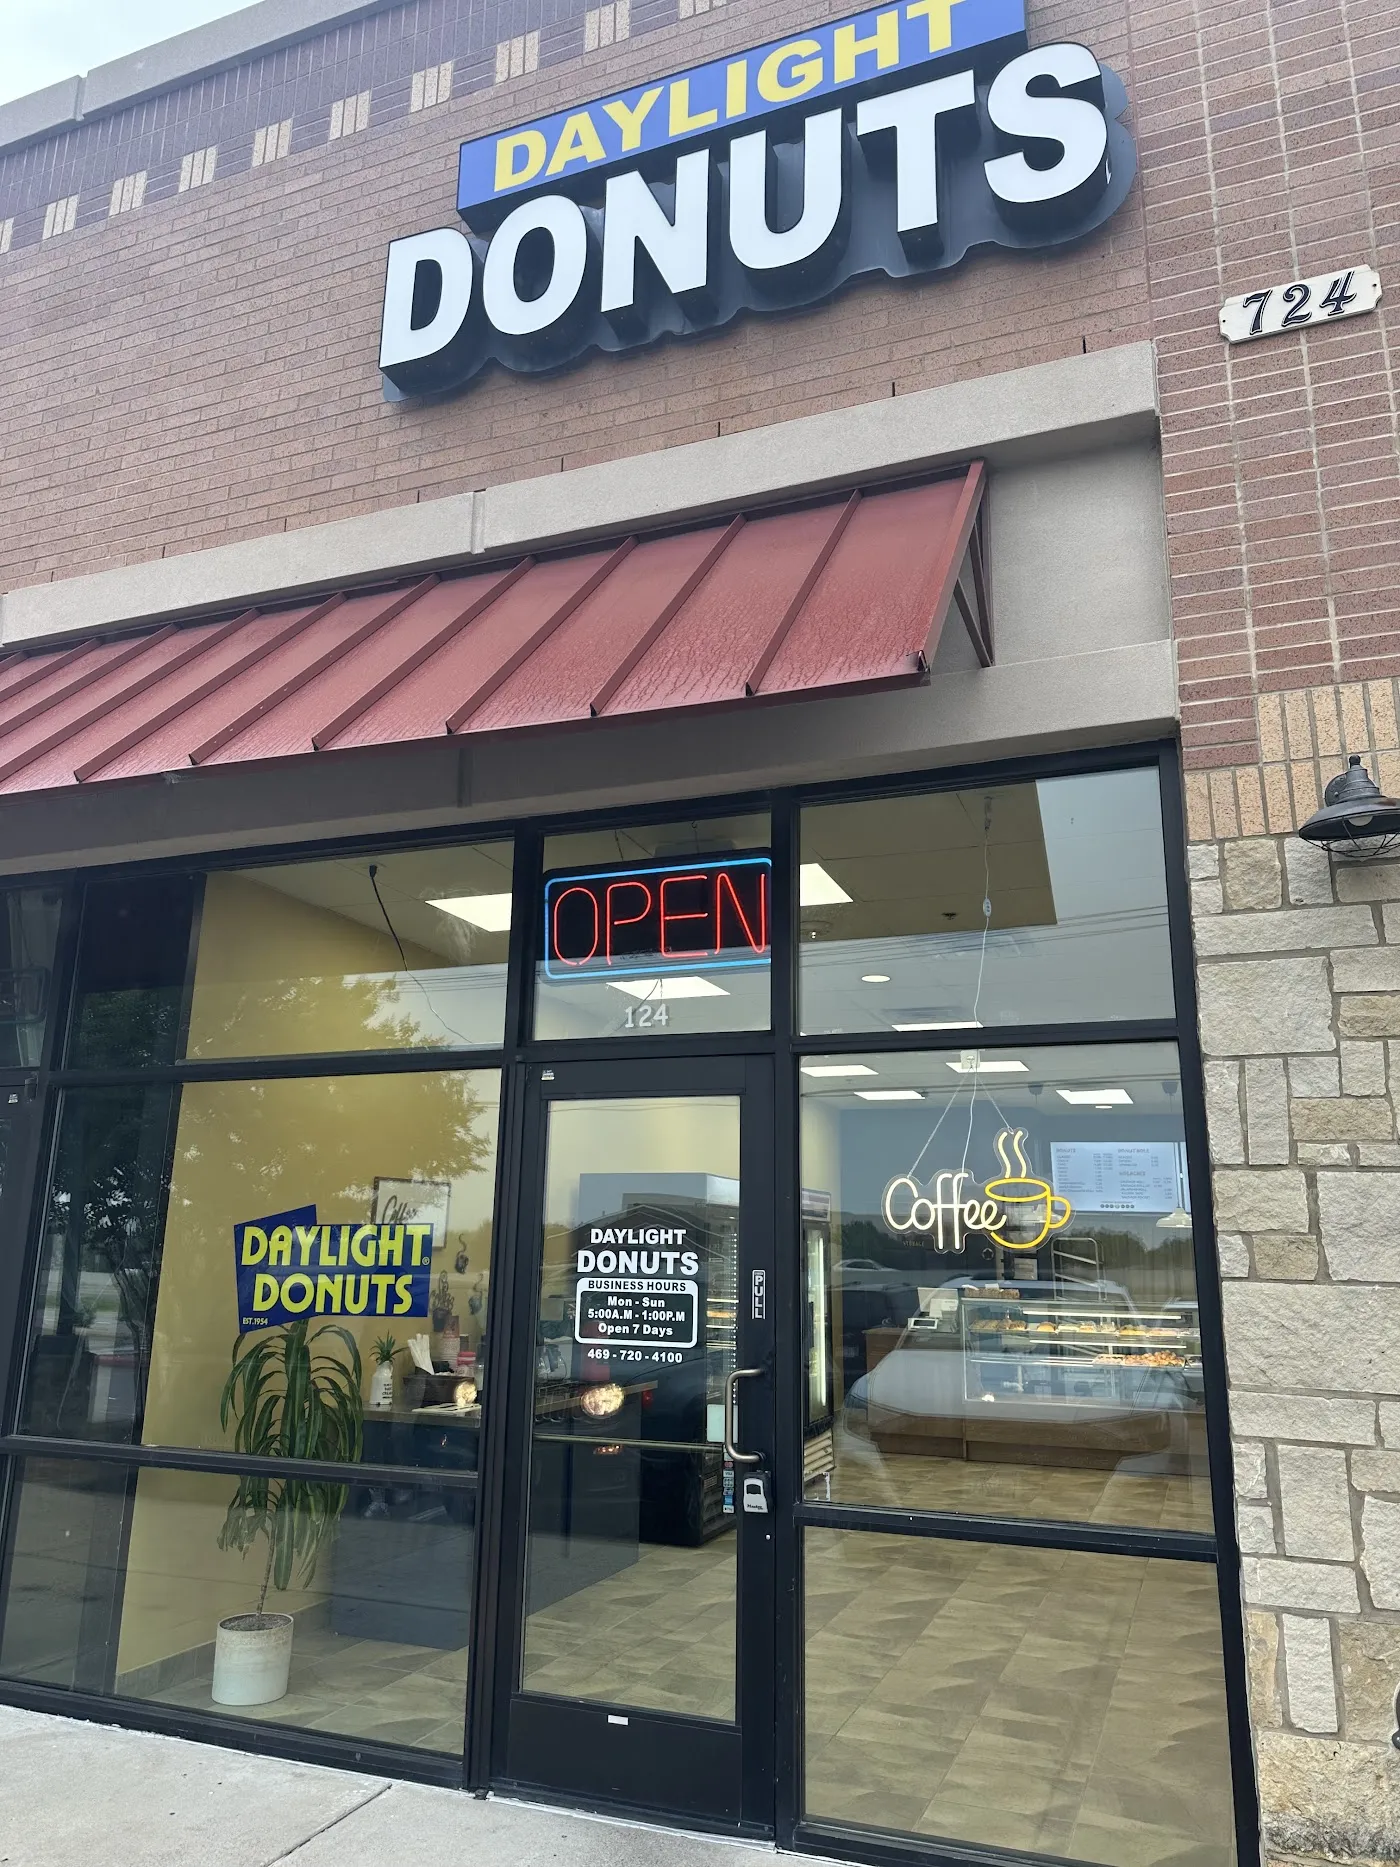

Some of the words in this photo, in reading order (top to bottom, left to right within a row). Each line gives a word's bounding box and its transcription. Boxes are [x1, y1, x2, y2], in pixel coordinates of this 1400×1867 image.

[493, 0, 967, 193] DAYLIGHT
[378, 42, 1108, 368] DONUTS
[1242, 271, 1357, 335] 724
[553, 872, 766, 967] OPEN
[624, 1003, 668, 1028] 124
[885, 1172, 1007, 1250] Coffee
[590, 1228, 686, 1245] DAYLIGHT
[577, 1250, 699, 1275] DONUTS
[253, 1273, 412, 1314] DONUTS
[588, 1280, 643, 1290] BUSINESS
[647, 1281, 686, 1291] HOURS
[754, 1275, 763, 1319] PULL
[607, 1296, 632, 1307] Mon
[642, 1297, 665, 1308] Sun
[242, 1317, 268, 1326] EST.1954
[588, 1309, 632, 1320] 5:00A.M
[642, 1310, 685, 1322] 1:00P.M
[598, 1324, 629, 1335] Open
[633, 1324, 639, 1334] 7
[643, 1325, 673, 1337] Days
[588, 1348, 610, 1360] 469
[620, 1350, 642, 1361] 720
[652, 1351, 683, 1363] 4100
